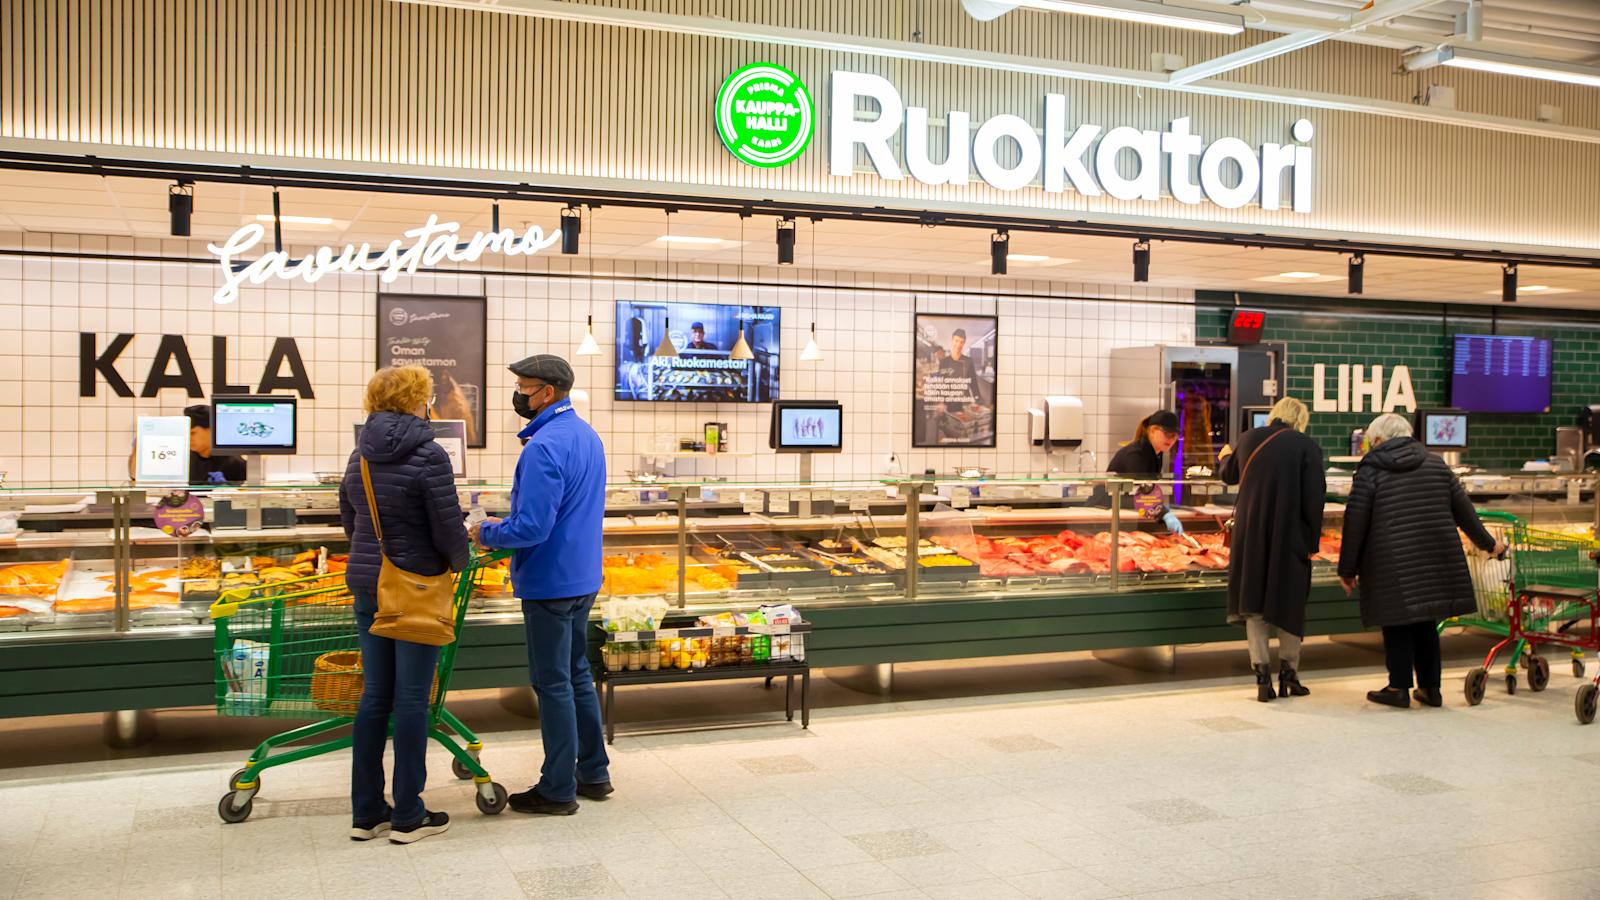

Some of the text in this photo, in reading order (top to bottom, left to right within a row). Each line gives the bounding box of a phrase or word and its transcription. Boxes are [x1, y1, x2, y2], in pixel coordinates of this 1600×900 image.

[746, 82, 784, 97] PRISMA
[735, 99, 800, 116] KAUPPA-
[746, 116, 788, 132] HALLI
[751, 136, 782, 148] KAARI
[829, 70, 1315, 213] Ruokatori
[207, 213, 563, 305] Savustamo
[391, 345, 425, 355] Oman
[79, 332, 316, 400] KALA
[391, 358, 457, 367] savustamon
[1313, 363, 1417, 413] LIHA
